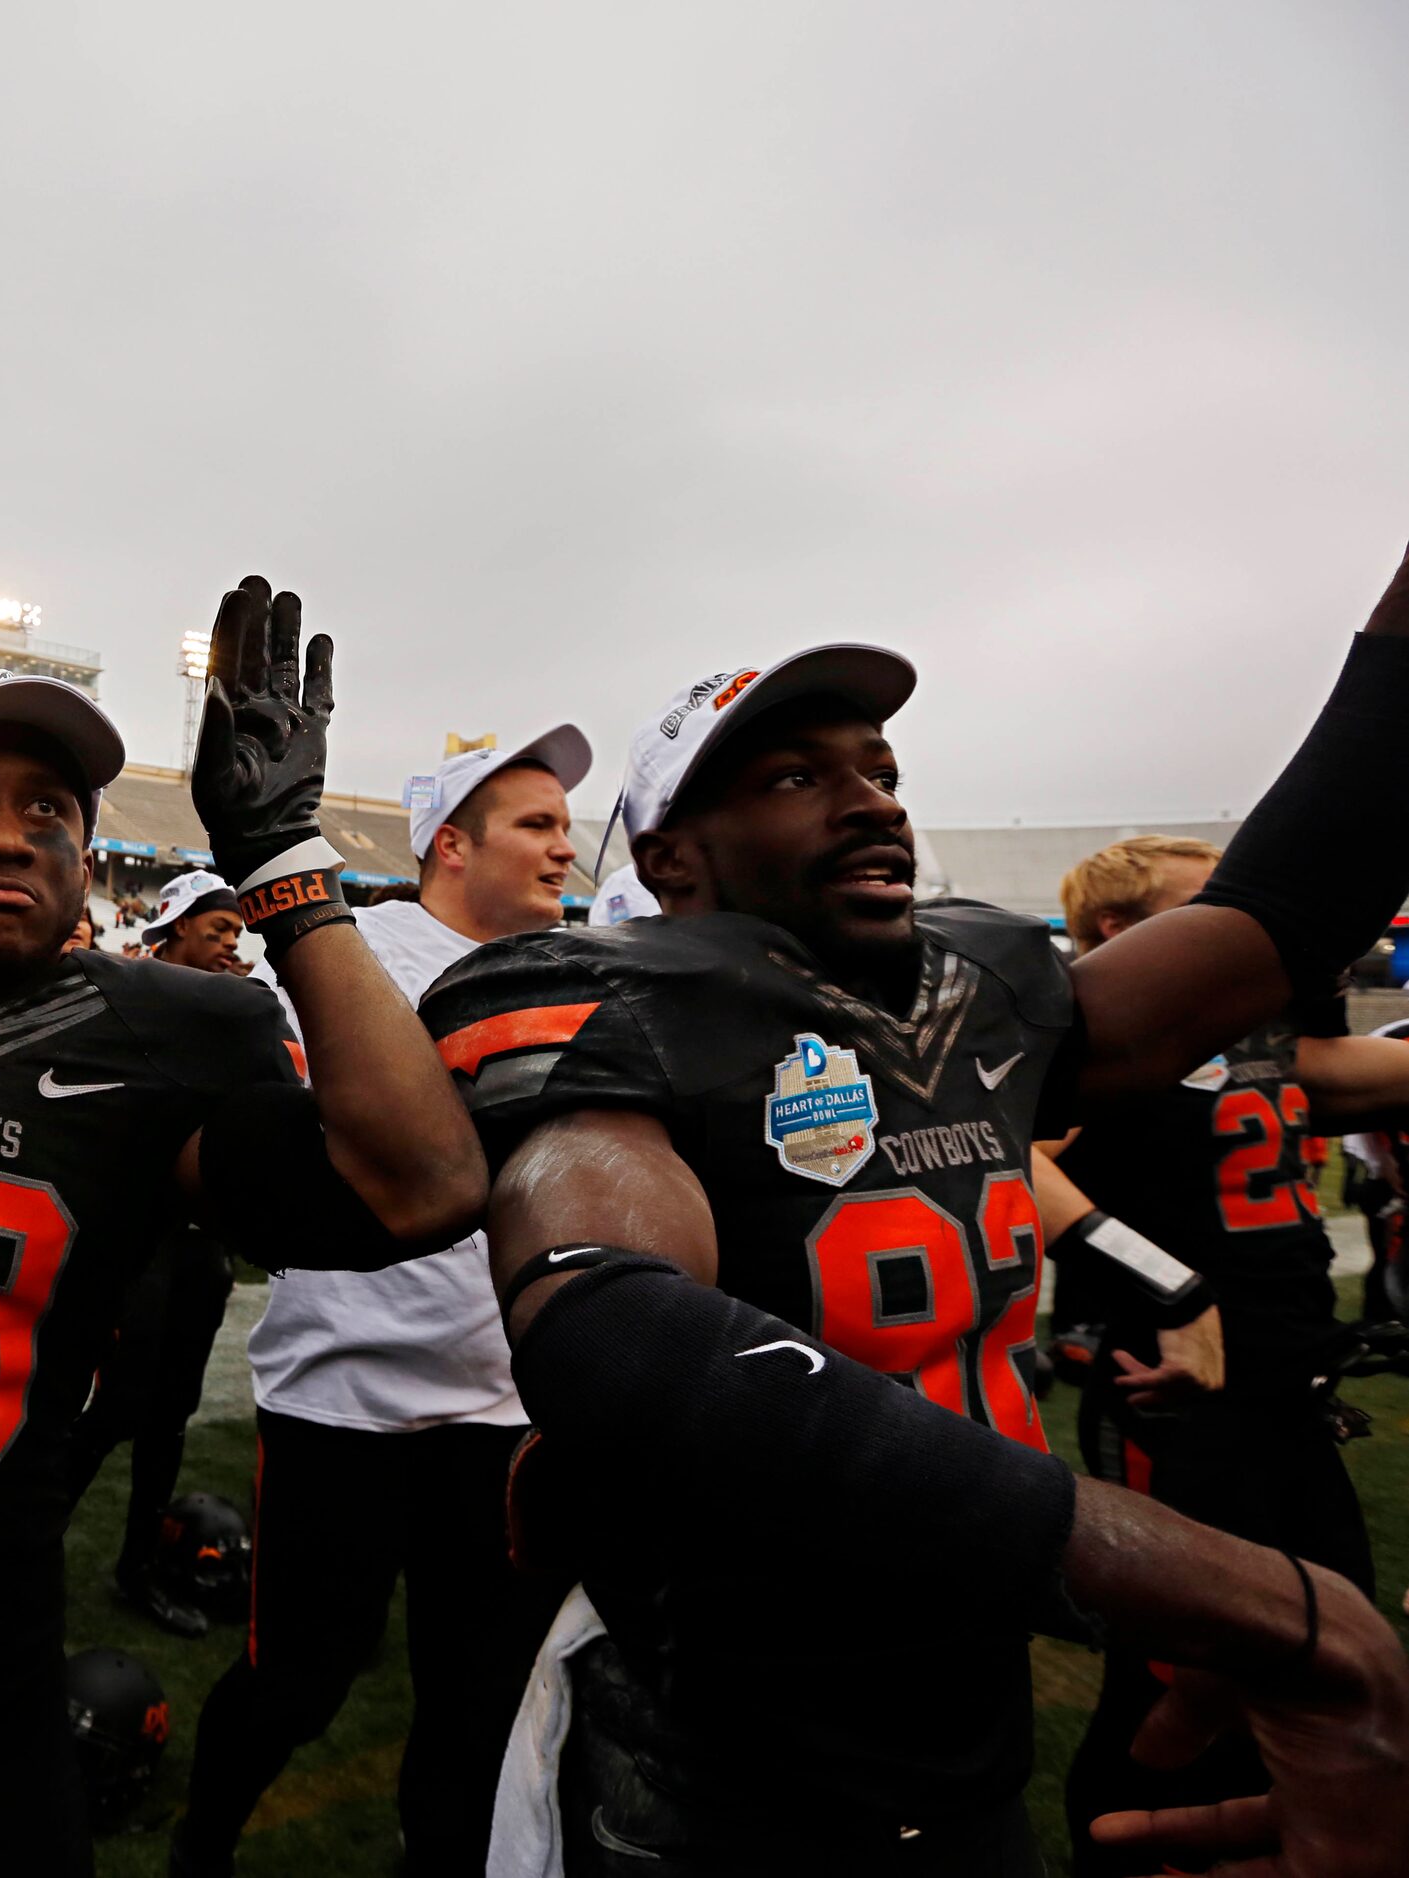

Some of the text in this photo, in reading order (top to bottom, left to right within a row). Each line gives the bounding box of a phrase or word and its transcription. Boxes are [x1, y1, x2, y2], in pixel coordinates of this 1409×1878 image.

[775, 1088, 865, 1118] HEART OF DALLAS
[813, 1108, 838, 1122] BOWL
[878, 1120, 1006, 1177] COWBOYS
